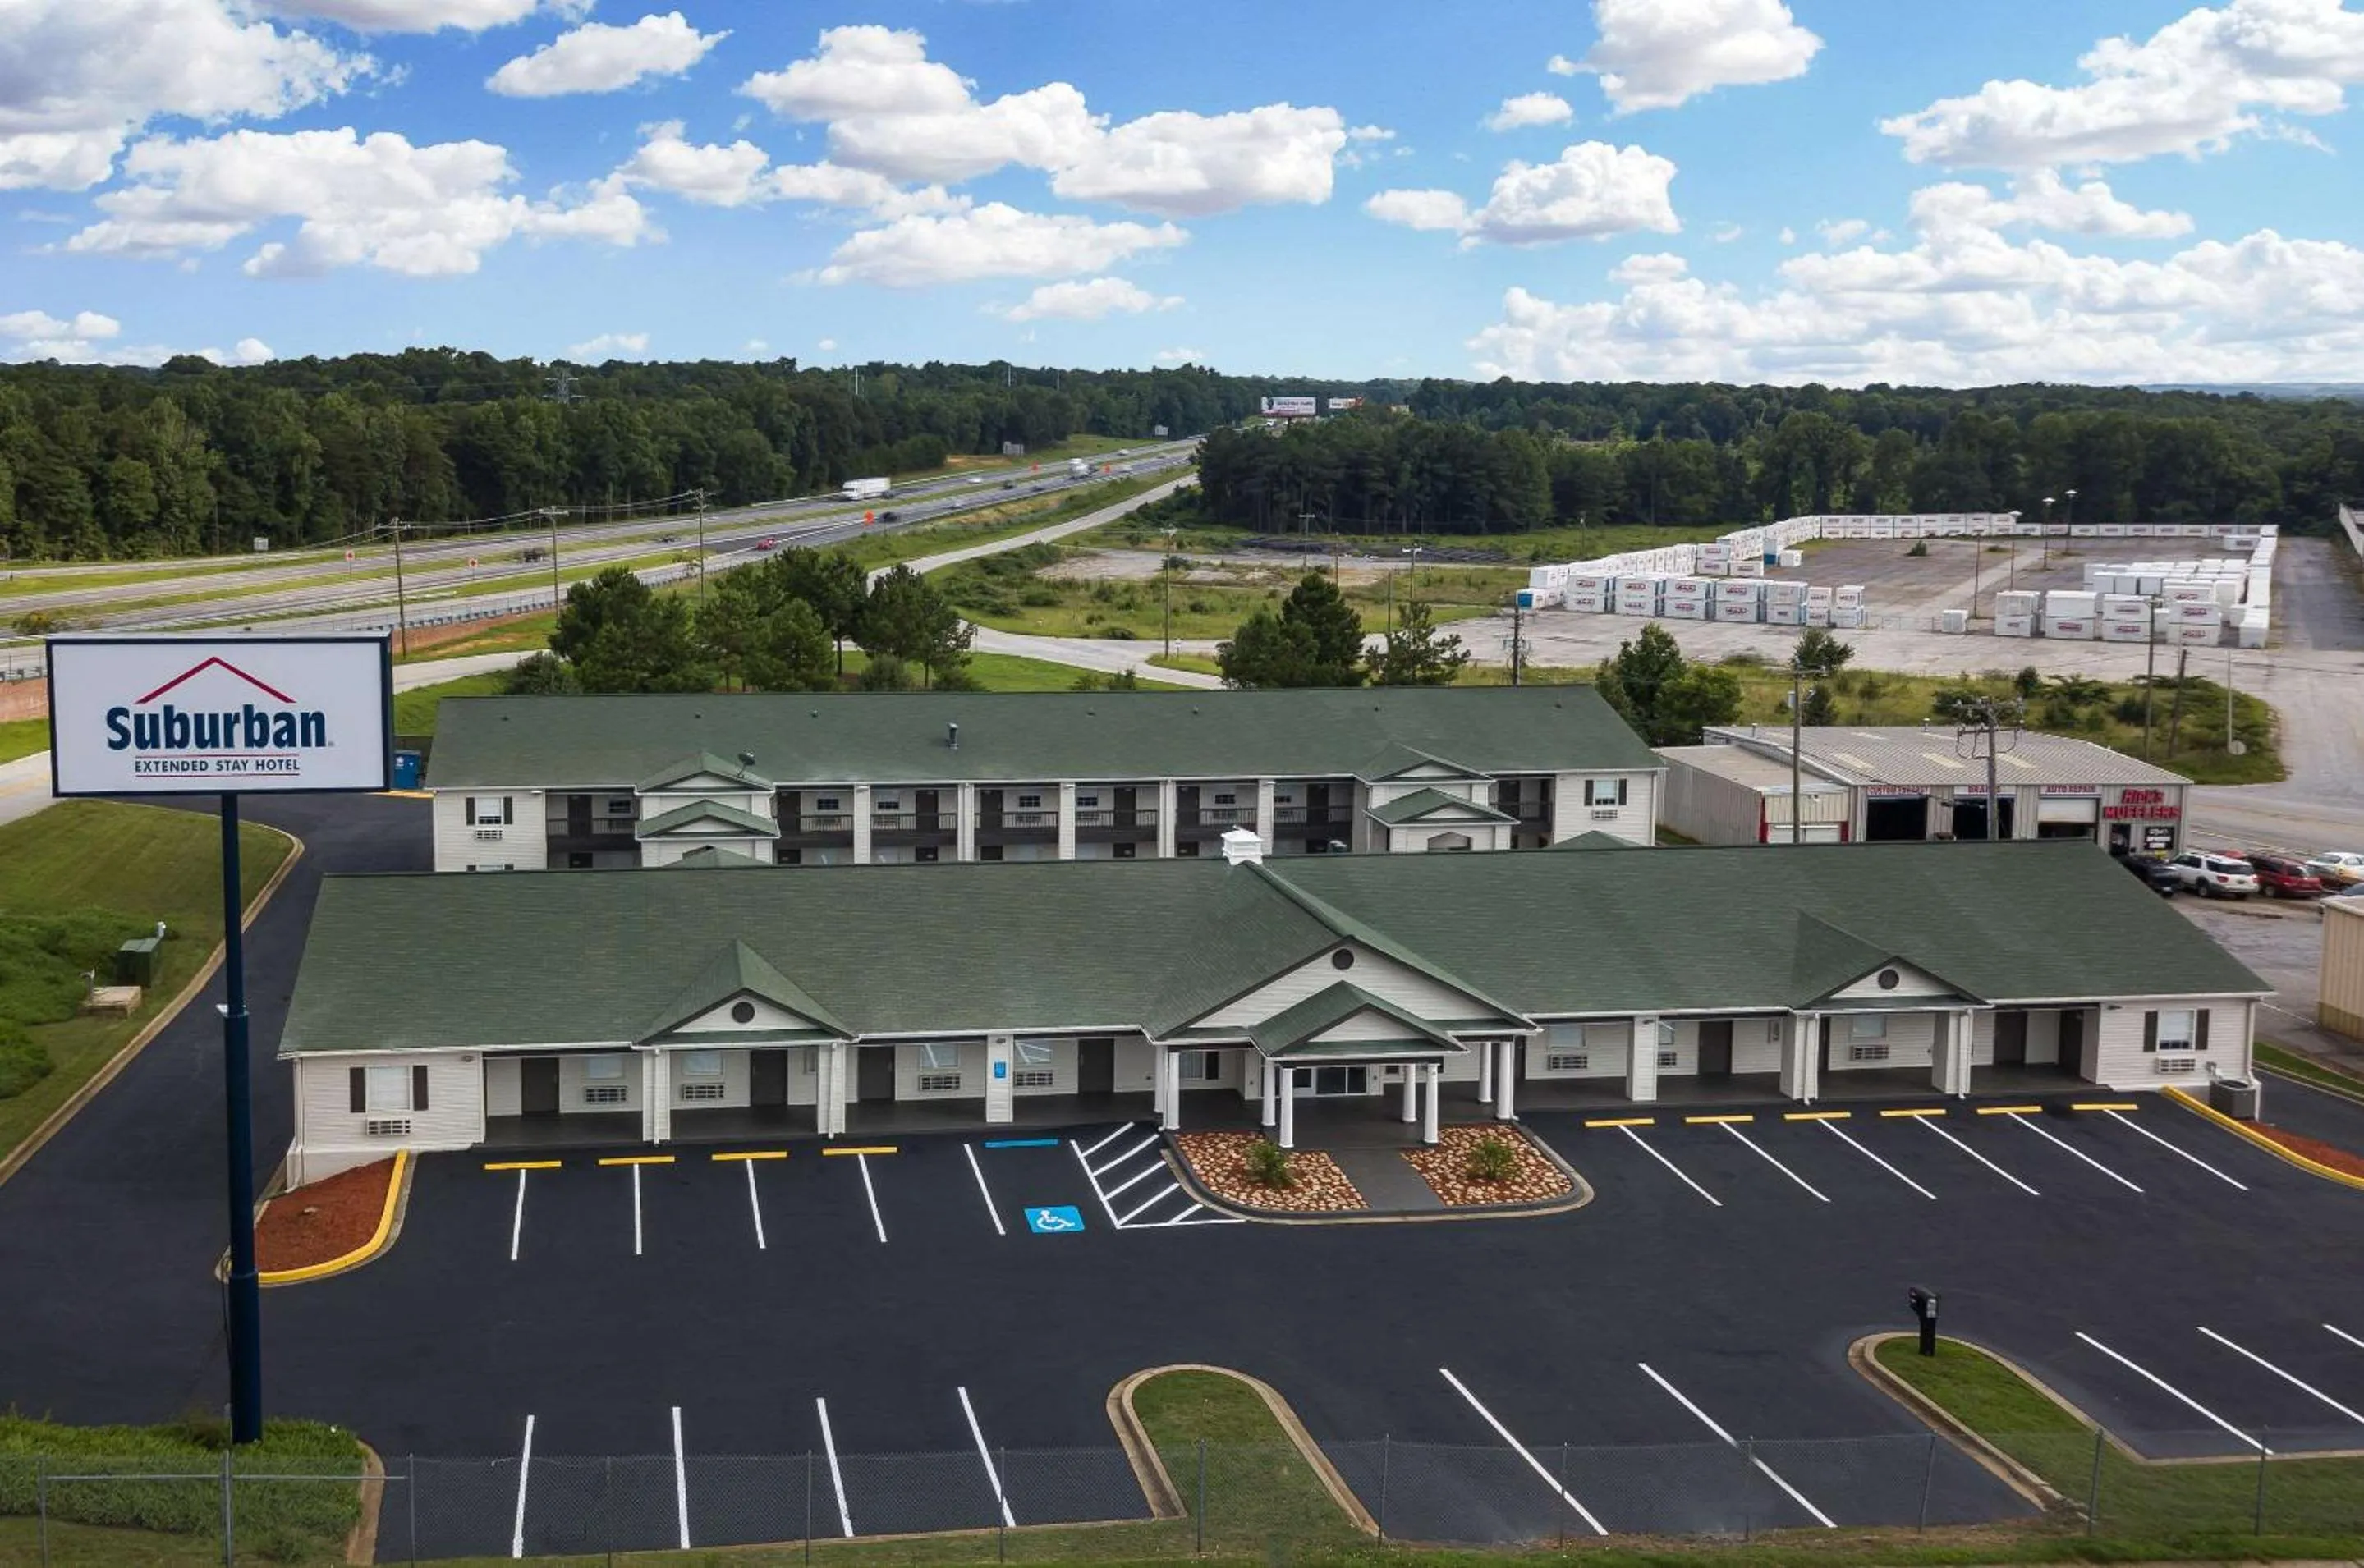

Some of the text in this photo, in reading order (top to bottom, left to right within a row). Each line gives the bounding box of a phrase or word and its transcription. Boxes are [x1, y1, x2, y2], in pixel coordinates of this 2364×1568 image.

[107, 704, 326, 750] Suburban
[135, 759, 300, 772] EXTENDED STAY HOTEL
